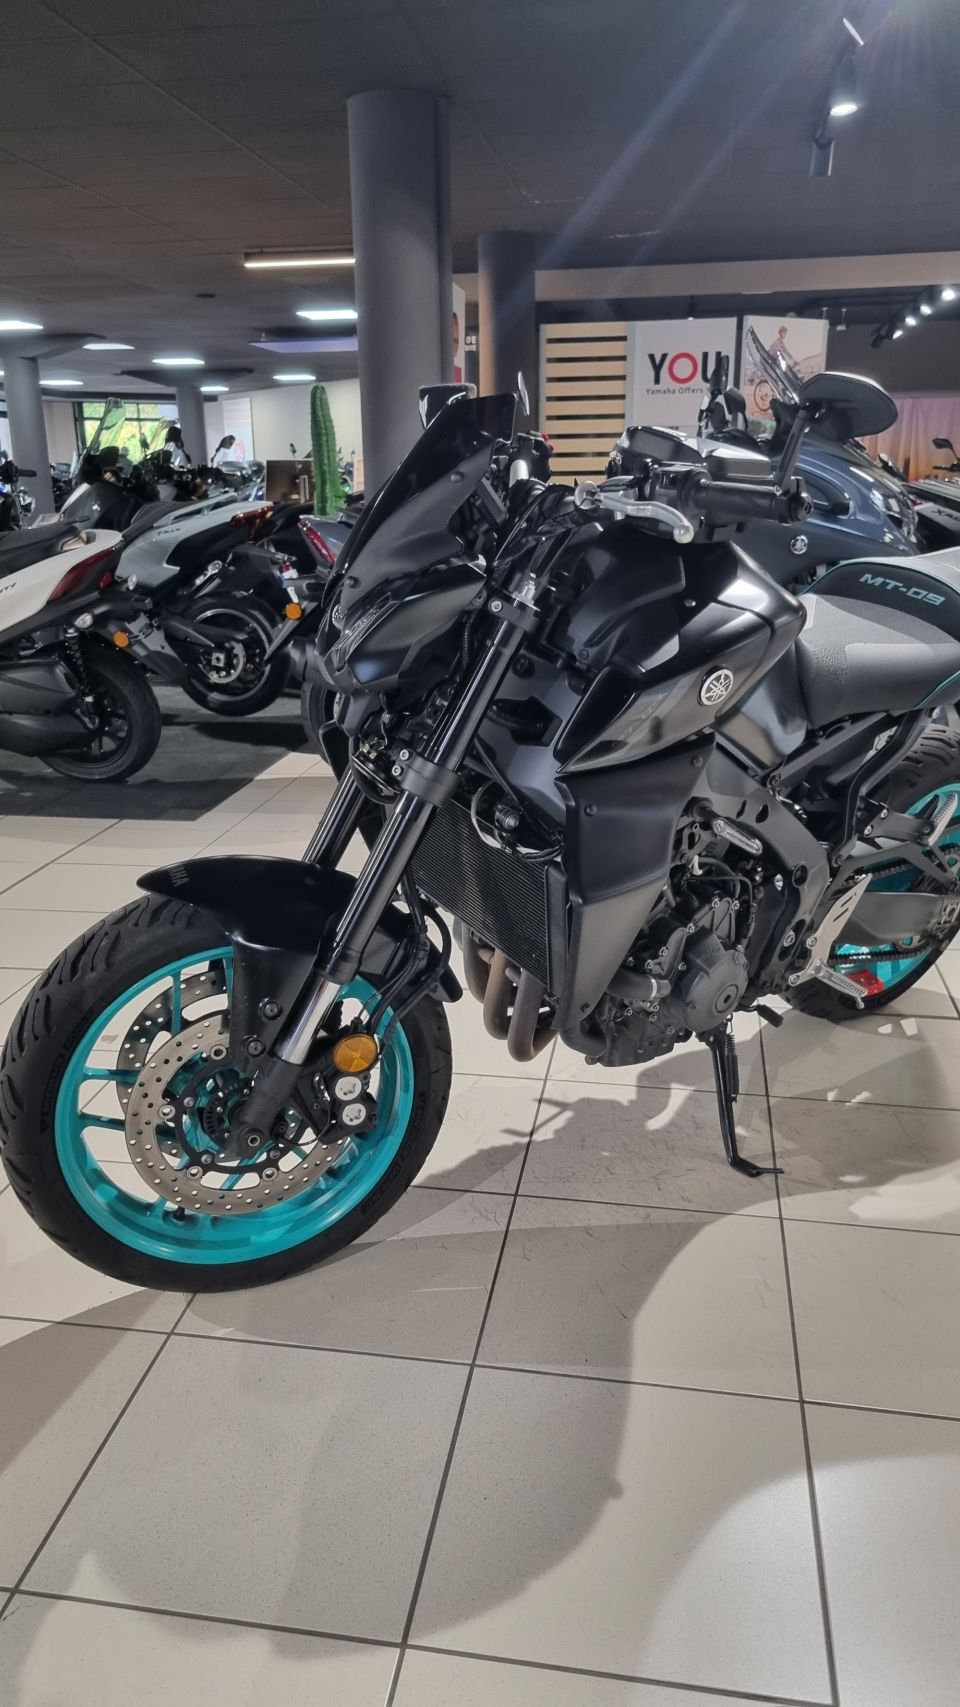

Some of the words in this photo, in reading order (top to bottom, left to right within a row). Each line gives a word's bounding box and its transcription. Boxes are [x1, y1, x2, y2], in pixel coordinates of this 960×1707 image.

[648, 351, 722, 385] YOU
[645, 387, 677, 396] Yamaha
[678, 386, 704, 395] Offers
[860, 573, 946, 606] MT-09
